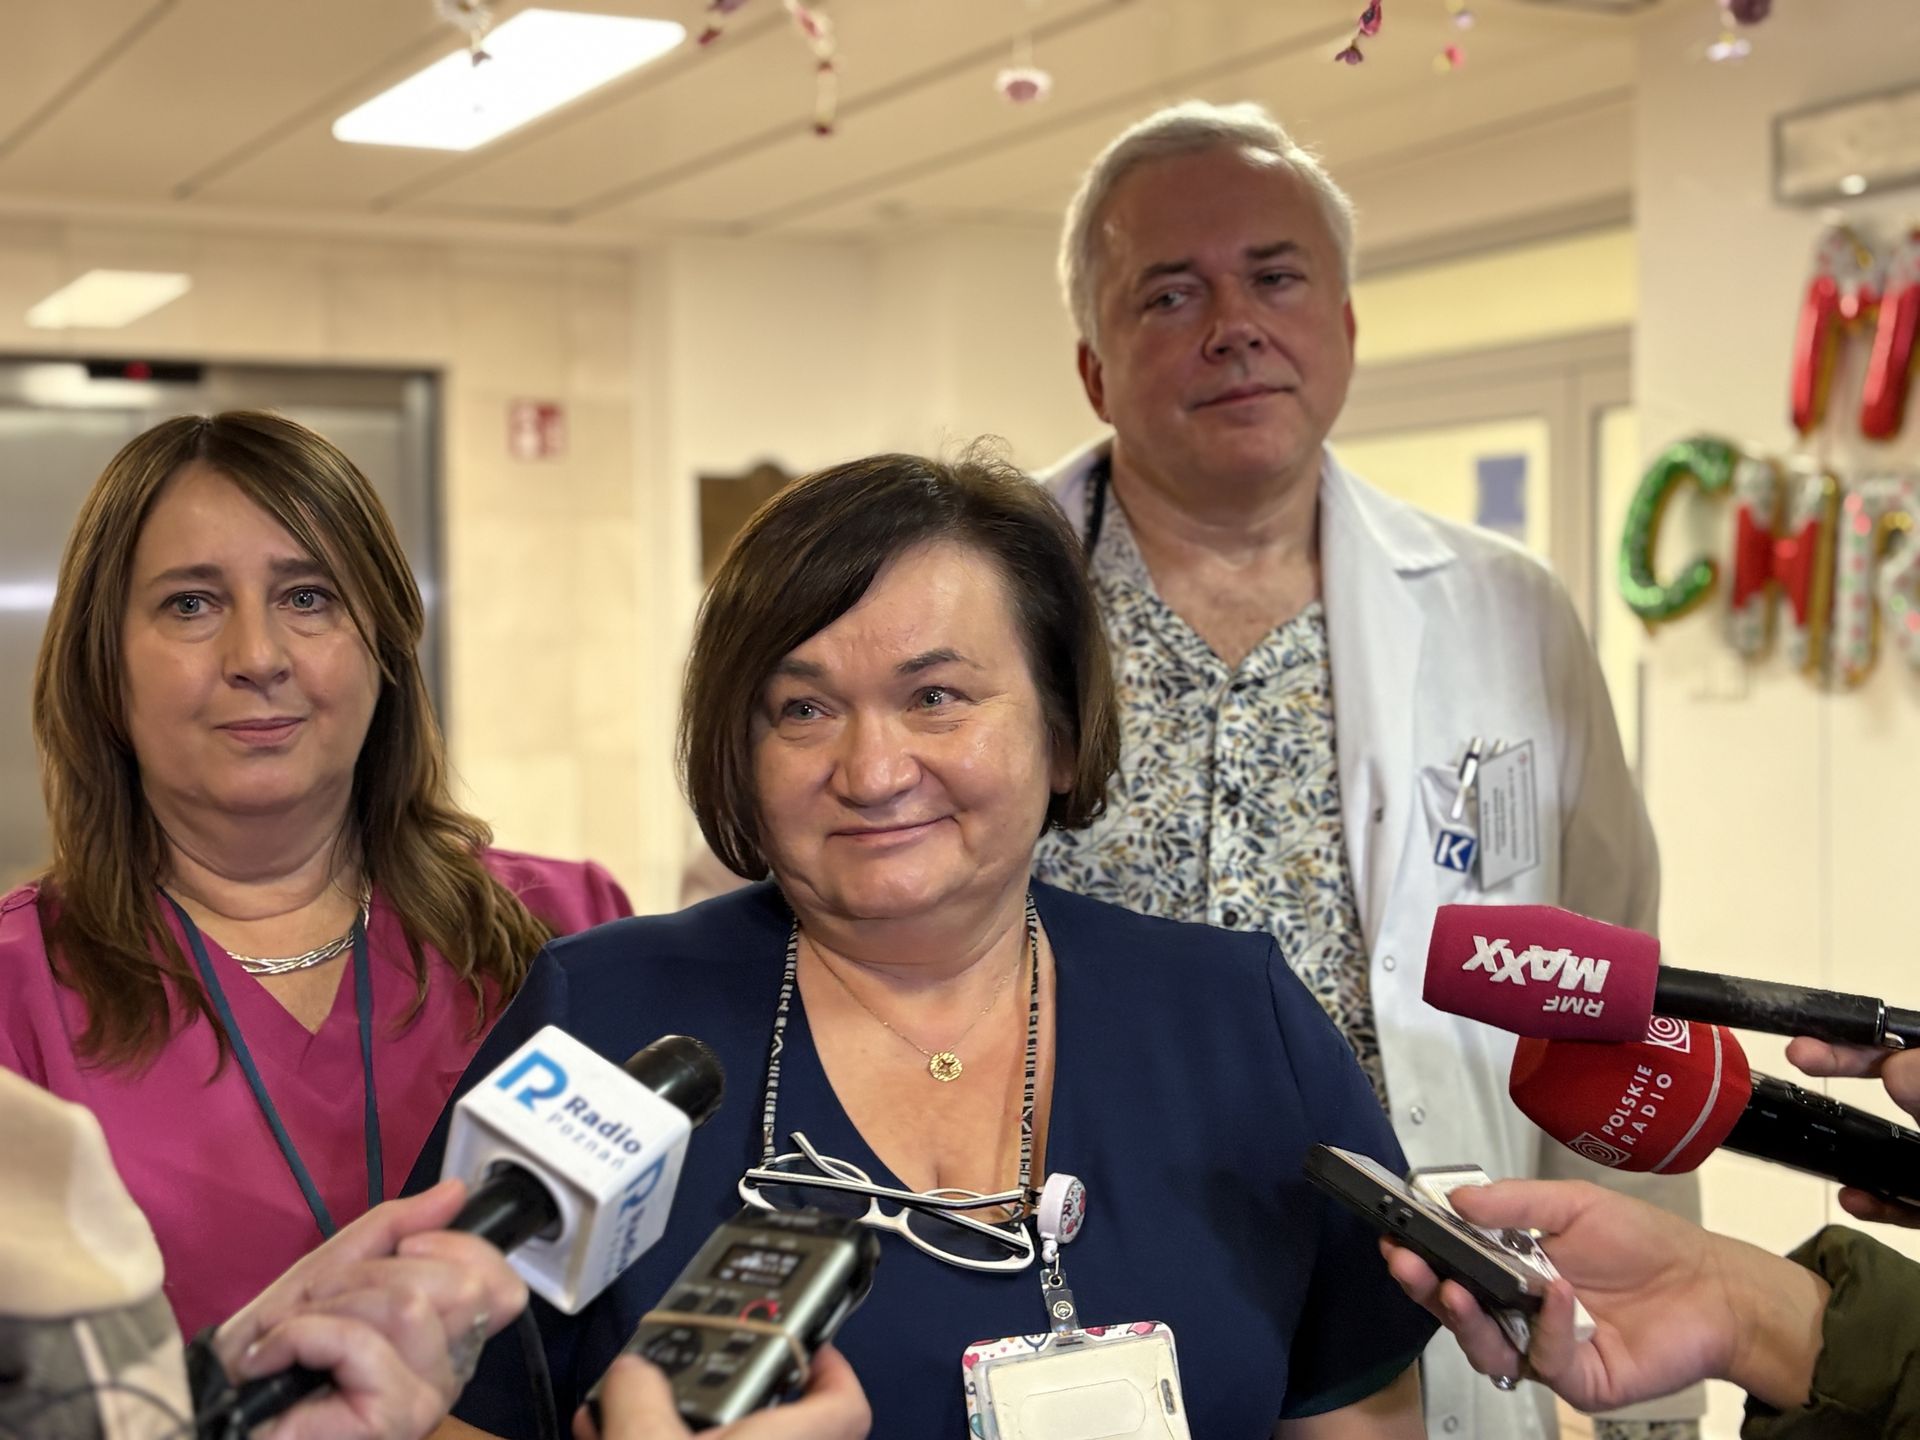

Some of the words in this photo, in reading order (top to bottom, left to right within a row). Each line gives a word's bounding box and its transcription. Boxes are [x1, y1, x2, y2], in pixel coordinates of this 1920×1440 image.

[1437, 834, 1471, 870] K
[1542, 995, 1605, 1018] RMF
[564, 1096, 642, 1156] Radio
[1601, 1063, 1653, 1137] POLSKIE
[1620, 1072, 1673, 1147] RADIO
